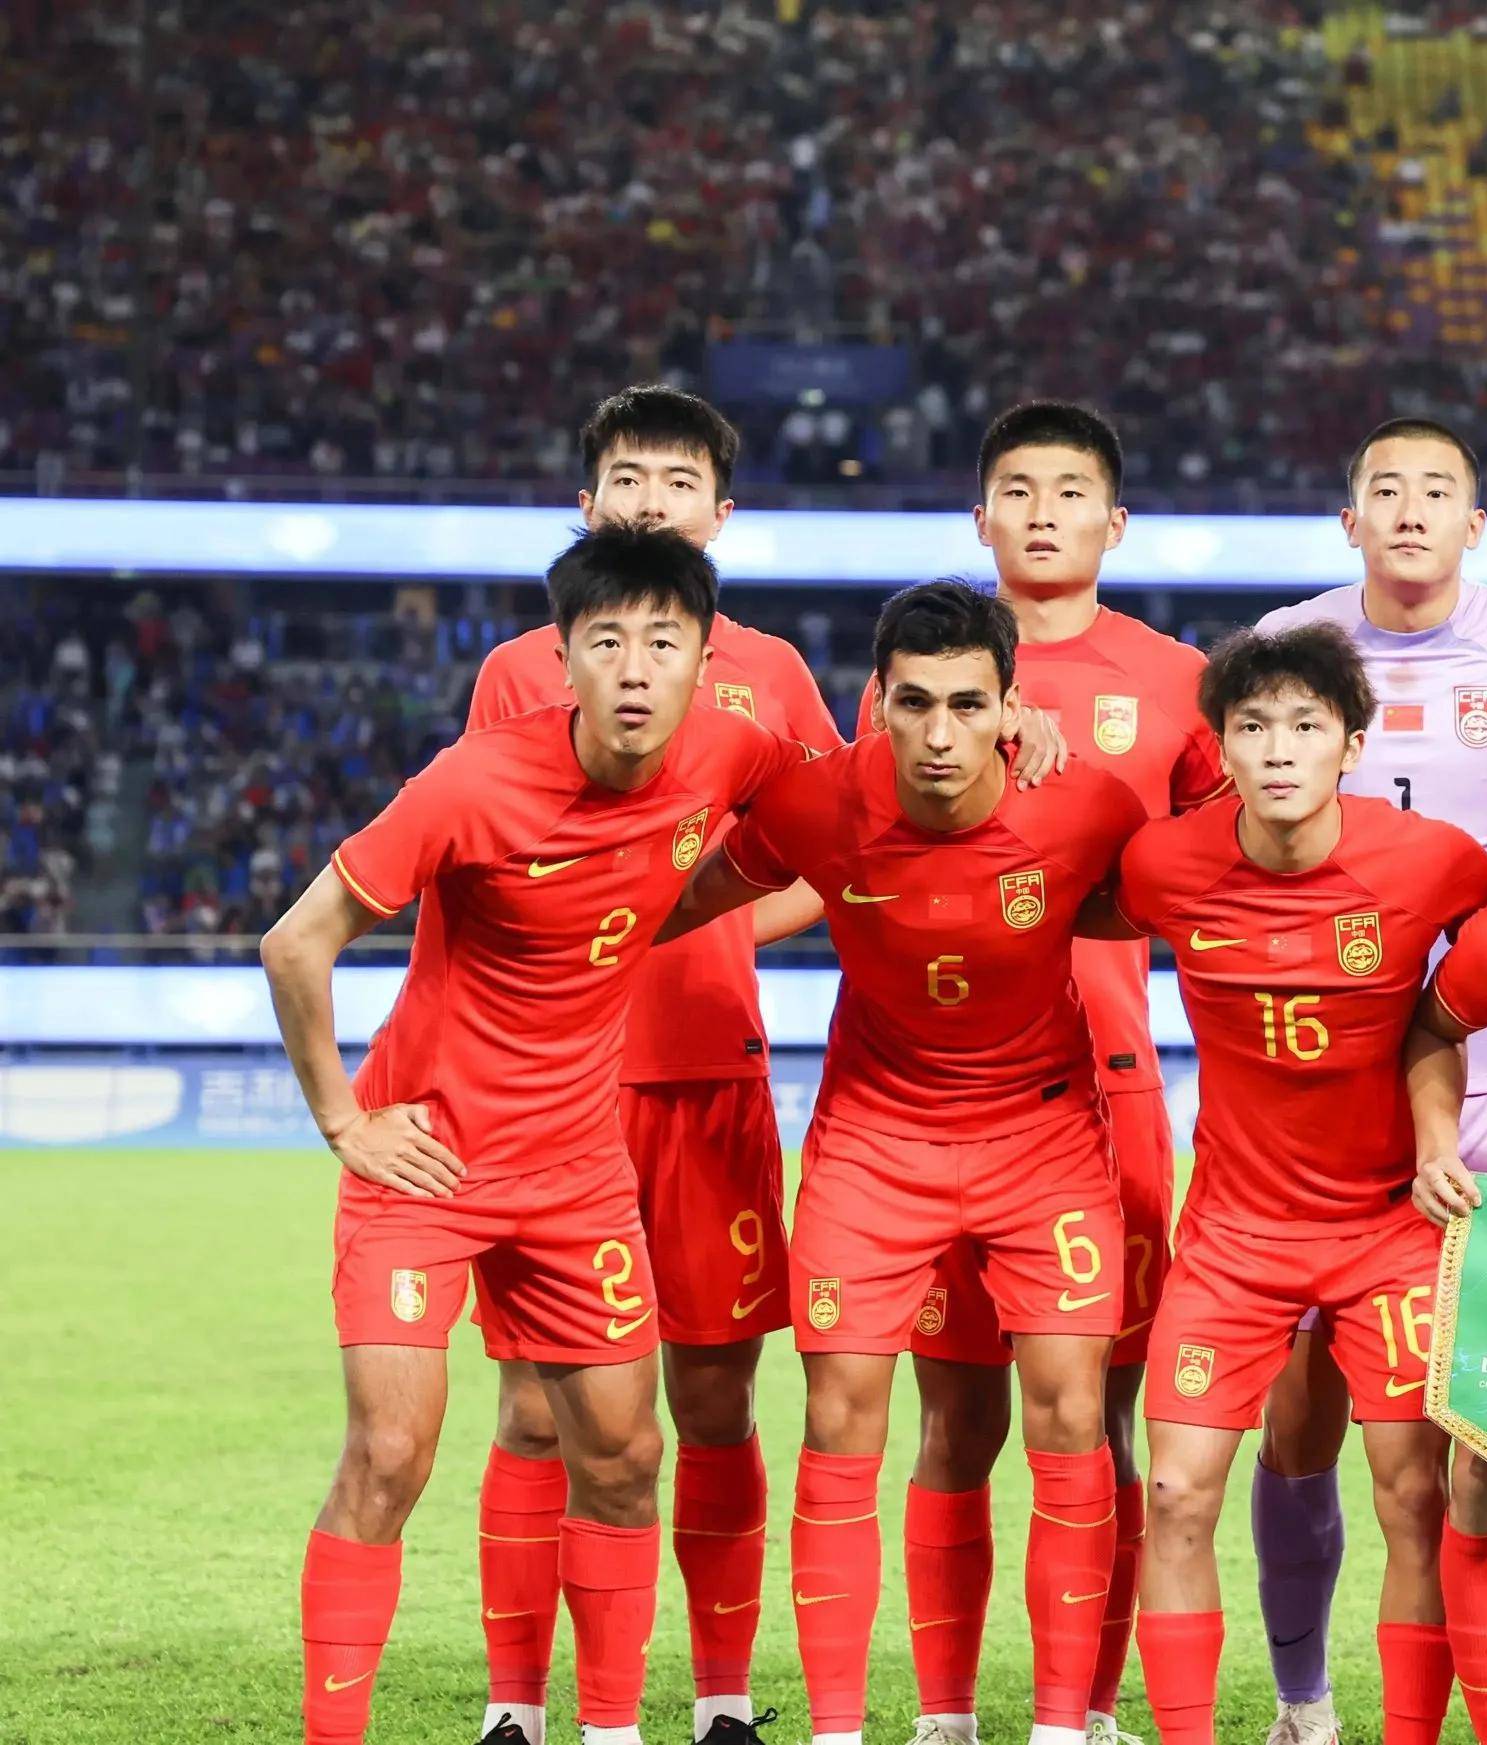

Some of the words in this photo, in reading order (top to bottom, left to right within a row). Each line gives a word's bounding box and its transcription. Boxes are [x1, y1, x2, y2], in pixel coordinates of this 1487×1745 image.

[719, 687, 750, 699] CFA
[679, 815, 704, 832] CFA
[1003, 874, 1040, 889] CFA
[589, 907, 637, 966] 2
[1340, 916, 1376, 930] CFA
[928, 955, 969, 1006] 6
[1254, 992, 1329, 1061] 16
[730, 1210, 764, 1284] 9
[1053, 1210, 1101, 1284] 6
[592, 1240, 643, 1311] 2
[813, 1281, 837, 1292] CFA
[927, 1290, 944, 1300] FA
[1372, 1286, 1434, 1368] 16
[1182, 1348, 1211, 1361] CFA
